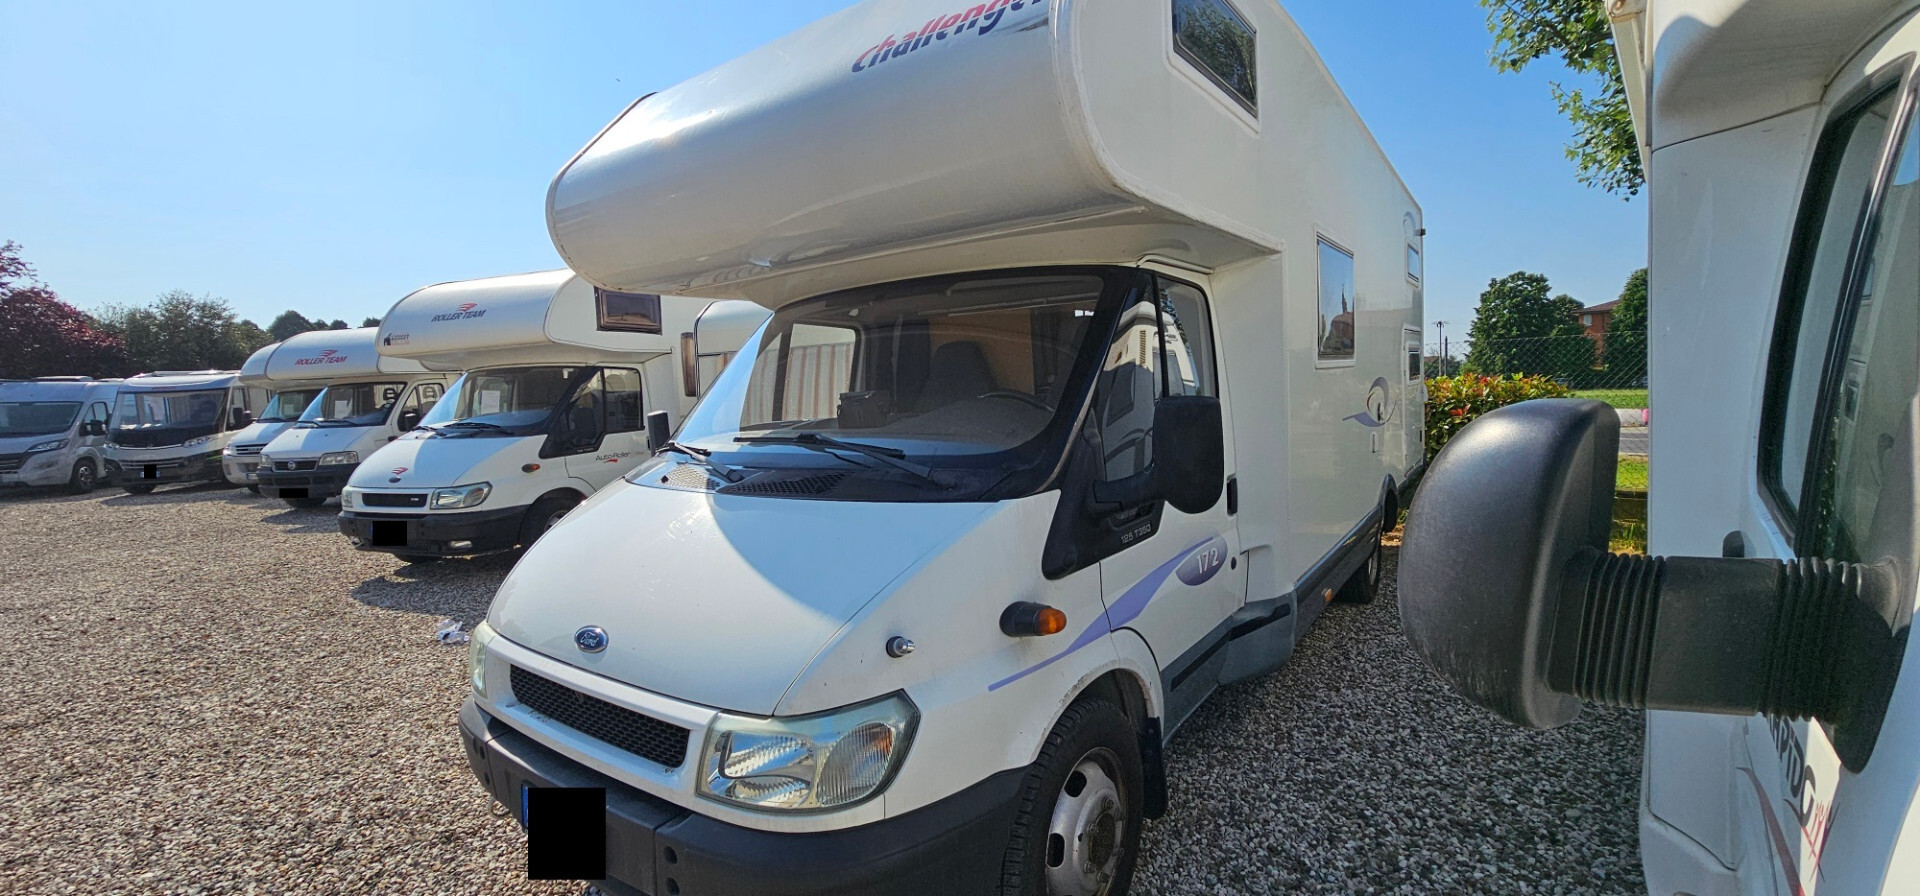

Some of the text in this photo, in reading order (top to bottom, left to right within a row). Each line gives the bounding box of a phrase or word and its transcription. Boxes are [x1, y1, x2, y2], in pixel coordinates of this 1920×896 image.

[851, 0, 1042, 73] Challeng
[431, 309, 488, 323] ROLLER TEAM
[295, 355, 348, 366] ROLLER TEAM
[1120, 530, 1134, 544] 125
[1196, 547, 1220, 575] 172
